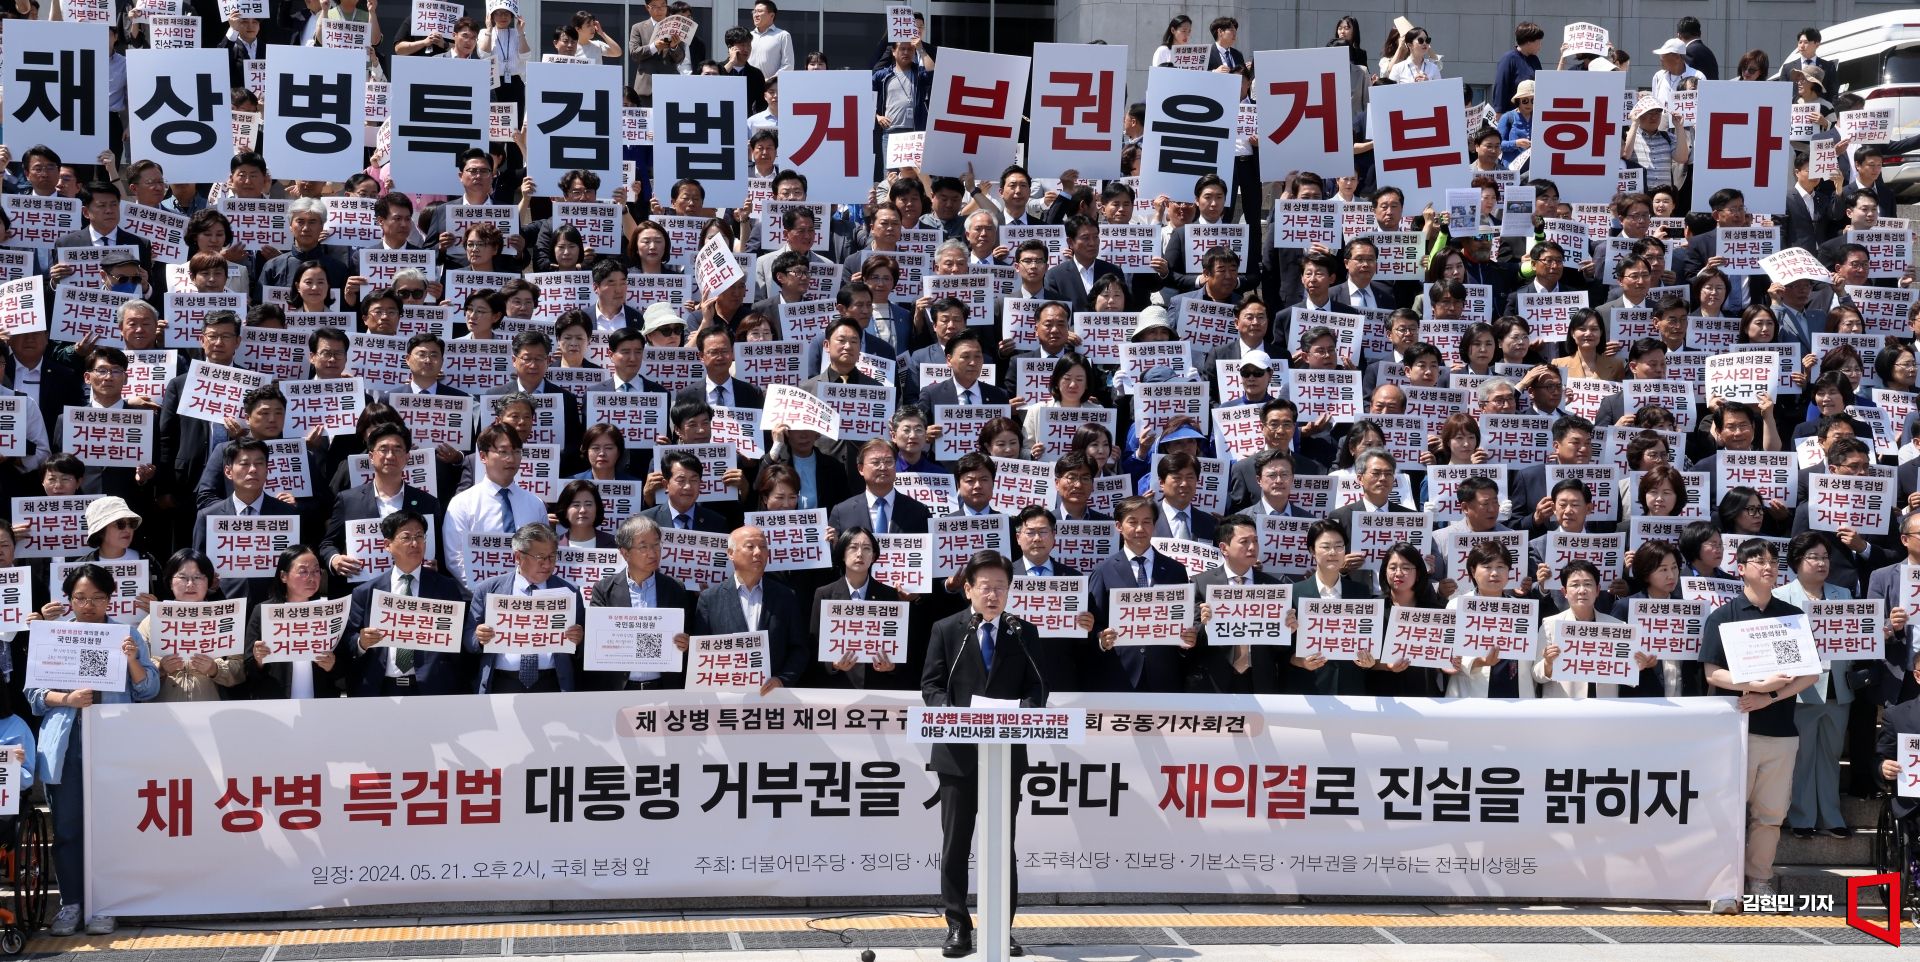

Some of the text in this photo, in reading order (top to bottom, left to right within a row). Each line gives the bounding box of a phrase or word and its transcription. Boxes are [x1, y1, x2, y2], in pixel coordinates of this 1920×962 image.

[154, 27, 196, 39] 수사외압
[12, 49, 95, 136] 채
[134, 73, 223, 156] 상
[278, 73, 352, 154] 병
[934, 75, 1012, 155] 부
[1041, 70, 1114, 151] 권
[1268, 72, 1339, 153] 거
[398, 83, 482, 169] 특
[537, 90, 610, 171] 검
[1848, 119, 1889, 131] 거부권을
[666, 100, 735, 182] 법
[789, 95, 859, 177] 거
[1152, 95, 1230, 175] 을
[1541, 96, 1616, 176] 한
[1848, 131, 1887, 142] 거부한다
[1383, 106, 1462, 189] 부
[1707, 106, 1782, 187] 다
[1283, 203, 1335, 213] 채 상병 특검법
[1283, 215, 1335, 228] 거부권을
[1282, 230, 1336, 243] 거부한다
[446, 357, 508, 372] 거부권을
[1709, 355, 1773, 368] 특검법 재의결로
[446, 374, 509, 388] 거부한다
[1711, 367, 1771, 383] 수사외압
[74, 411, 142, 424] 채 상병 특검법
[73, 425, 143, 443] 거부권을
[71, 444, 144, 461] 거부한다
[1819, 478, 1883, 492] 채 상병 특검법
[1818, 492, 1883, 510] 거부권을
[1818, 510, 1883, 528] 거부한다
[1120, 589, 1185, 603] 채 상병 특검법
[1212, 589, 1286, 600] 특검법 재의결로
[162, 603, 235, 617] 채 상병 특검법
[498, 598, 567, 611] 채 상병 특검법
[832, 604, 898, 617] 채 상병 특검법
[1120, 604, 1186, 622] 거부권을
[1214, 603, 1283, 619] 수사외압
[1309, 603, 1374, 615] 채 상병 특검법
[1467, 600, 1530, 615] 채 상병 특검법
[161, 617, 235, 636] 거부권을
[496, 613, 567, 629] 거부권을
[830, 620, 899, 637] 거부권을
[1307, 618, 1374, 634] 거부권을
[1465, 615, 1530, 634] 거부권을
[1215, 622, 1280, 638] 진상규명
[1566, 625, 1632, 639] 채 상병 특검법
[160, 634, 235, 655] 거부한다
[494, 631, 567, 647] 거부한다
[700, 636, 761, 651] 채 상병 특검법
[1564, 640, 1631, 658] 거부권을
[698, 651, 763, 669] 거부권을
[1562, 659, 1631, 677] 거부한다
[696, 671, 766, 687] 거부한다
[636, 710, 656, 733] 채
[664, 709, 709, 732] 상병
[717, 708, 784, 731] 특검법
[793, 708, 836, 730] 재의
[844, 709, 889, 730] 요구
[1110, 714, 1245, 733] 공동기자회견
[922, 712, 933, 724] 채
[935, 713, 958, 724] 상병
[960, 713, 994, 725] 특검법
[996, 713, 1019, 725] 재의
[1021, 714, 1043, 725] 요구
[1045, 714, 1069, 726] 규탄
[921, 726, 1068, 739] 야당·시민사회 공동기자회견
[137, 758, 1699, 837] 채 상병 특검법 대통령 거부권을 한다 재의결로 진실을 밝히자
[311, 857, 650, 885] 일정: 2024. 05. 21. 오후 2시, 국회 본청 앞
[694, 855, 735, 875] 주최:
[742, 853, 846, 873] 더불어민주당
[860, 853, 911, 872] 정의당
[1024, 851, 1111, 870] 조국혁신당
[1124, 852, 1176, 870] 진보당
[1189, 853, 1276, 872] 기본소득당
[1289, 854, 1358, 873] 거부권을
[1362, 856, 1431, 874] 거부하는
[1435, 857, 1539, 875] 전국비상행동
